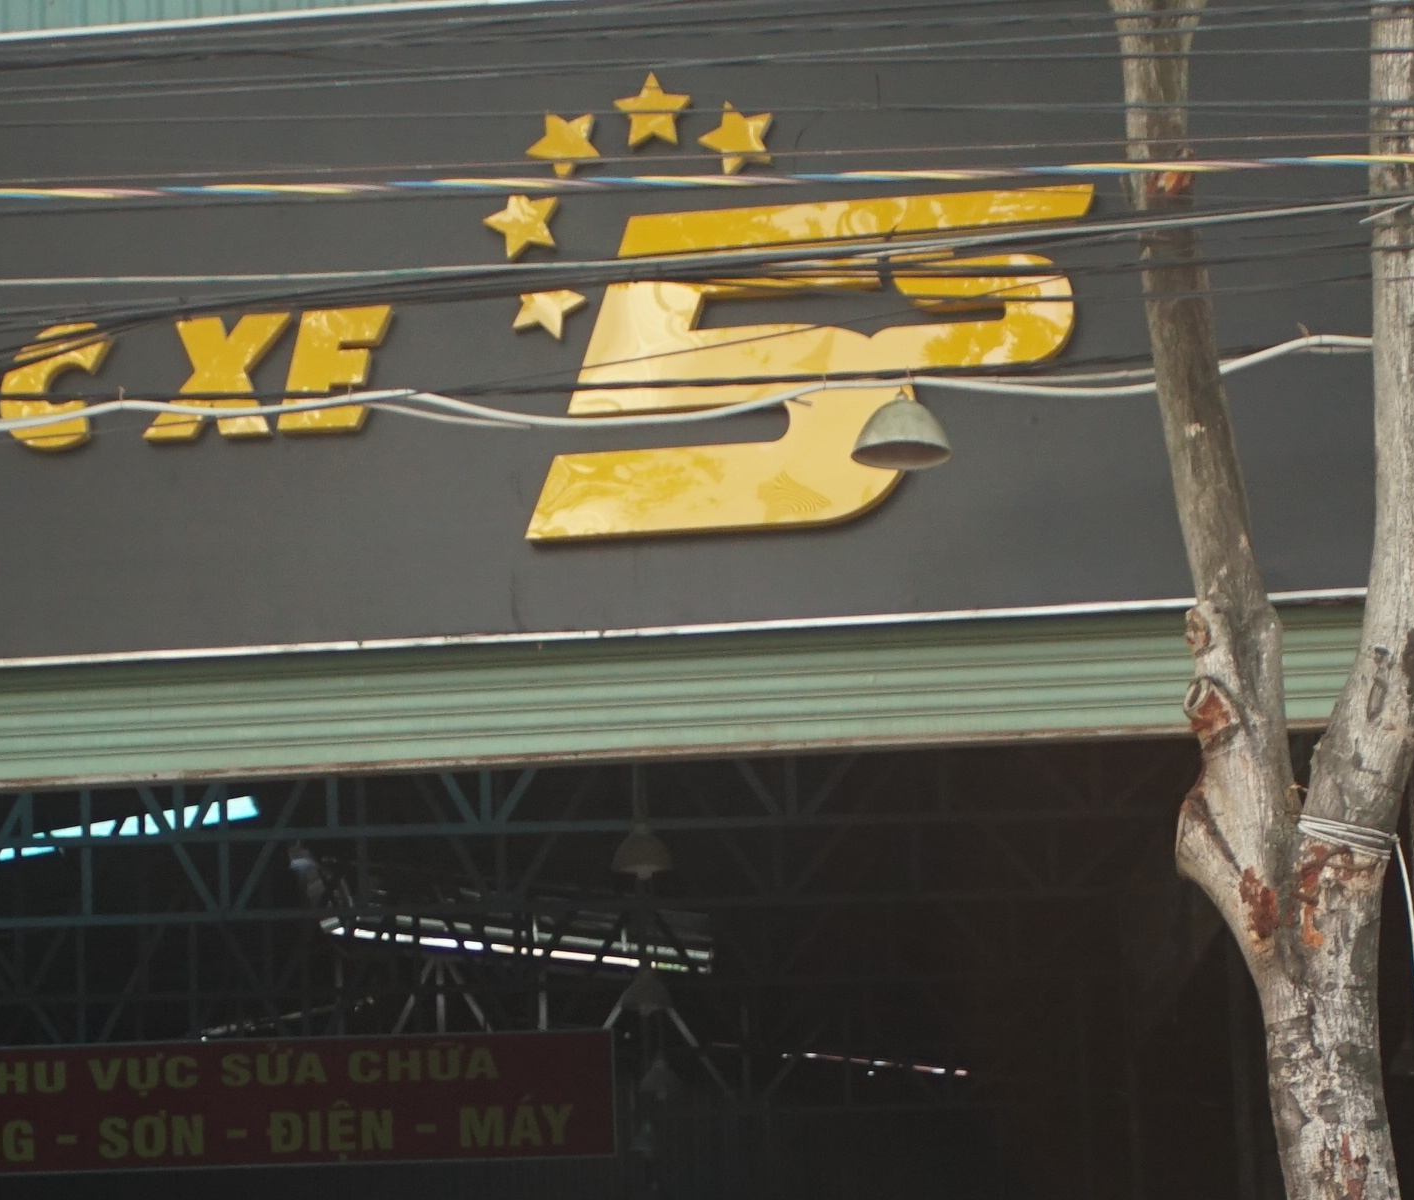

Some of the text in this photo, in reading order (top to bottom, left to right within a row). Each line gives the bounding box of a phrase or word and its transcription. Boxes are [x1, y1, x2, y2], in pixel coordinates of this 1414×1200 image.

[142, 304, 393, 442] XE
[88, 1055, 199, 1096] VỰC
[220, 1046, 327, 1087] SỬA
[347, 1041, 498, 1082] CHỮA
[98, 1112, 205, 1159] SƠN
[268, 1101, 396, 1162] ĐIỆN
[460, 1094, 575, 1149] MÁY
